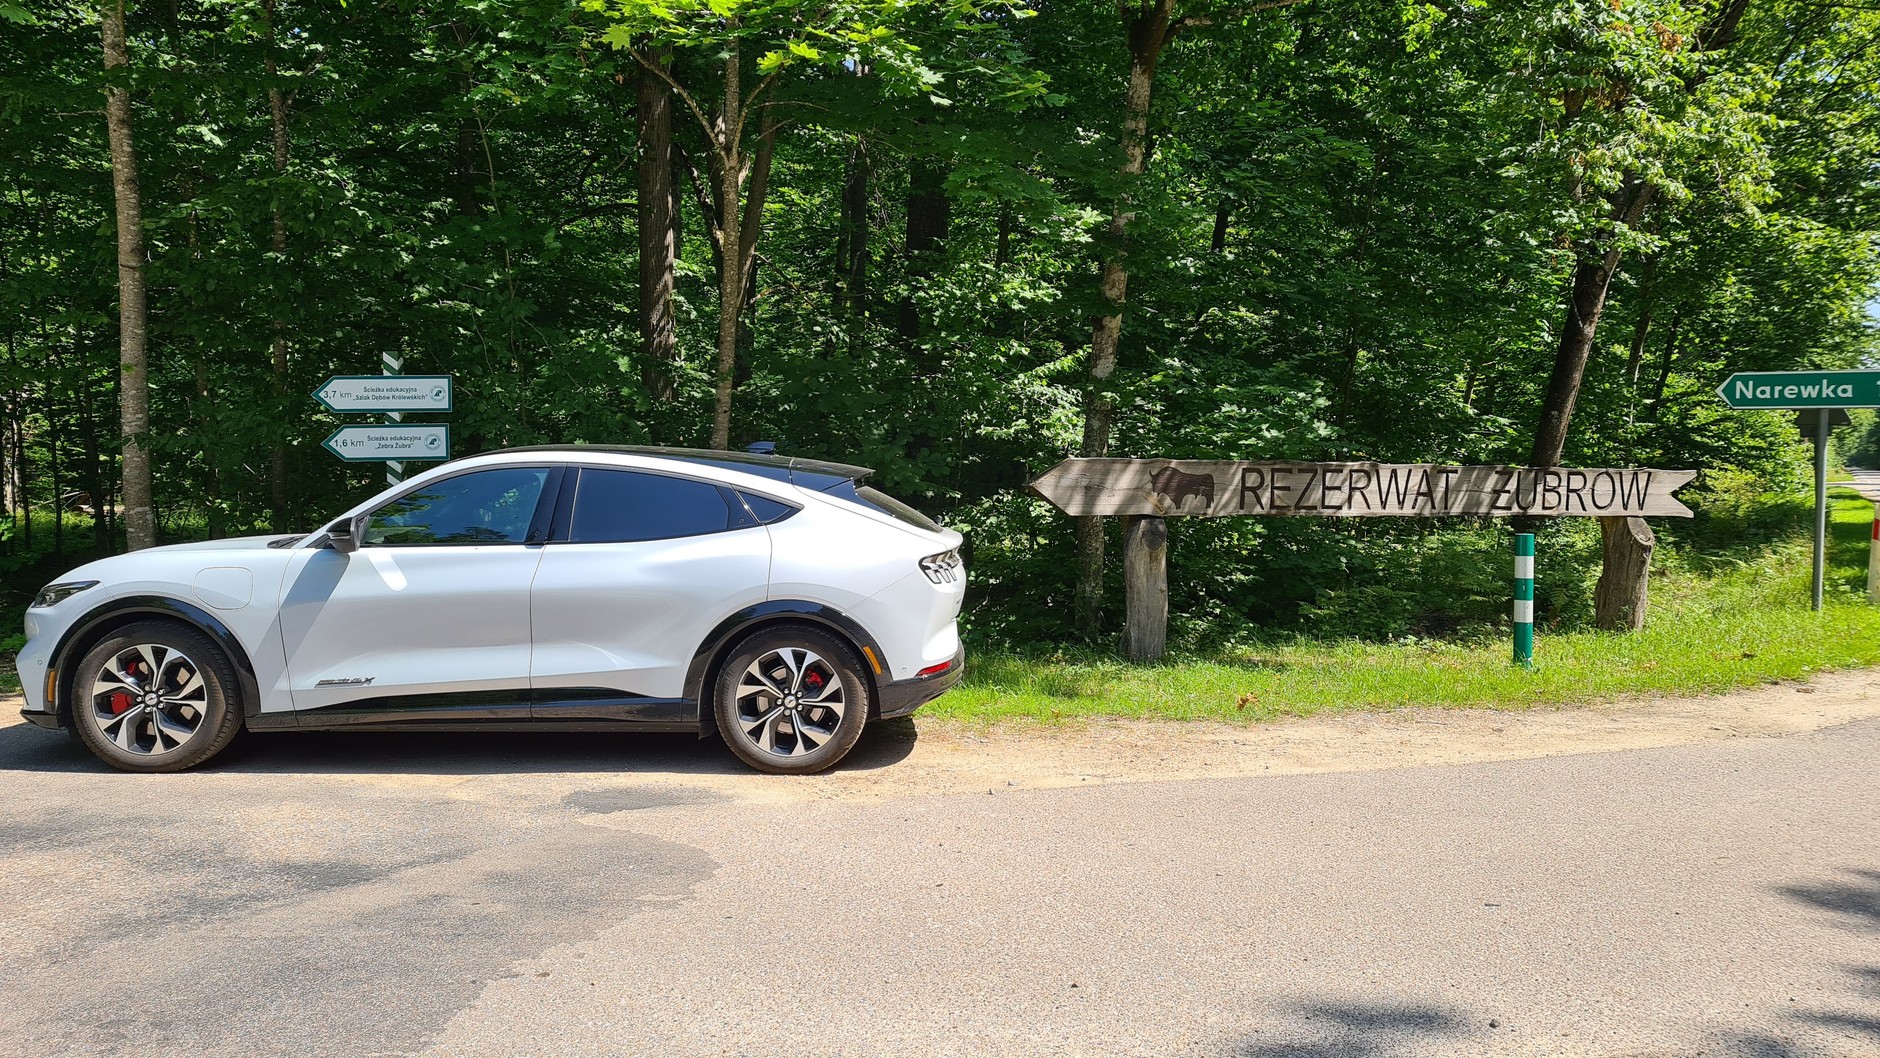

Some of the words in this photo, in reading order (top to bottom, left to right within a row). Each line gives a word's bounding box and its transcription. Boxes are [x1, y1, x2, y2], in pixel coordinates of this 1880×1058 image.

[385, 386, 417, 394] edukacyjna
[1735, 379, 1853, 399] Narewka
[323, 390, 337, 399] 3,7
[339, 391, 352, 399] km
[334, 439, 348, 448] 1,6
[350, 439, 364, 447] km
[389, 435, 421, 443] edukacyjna
[1239, 467, 1459, 511] REZERWAT
